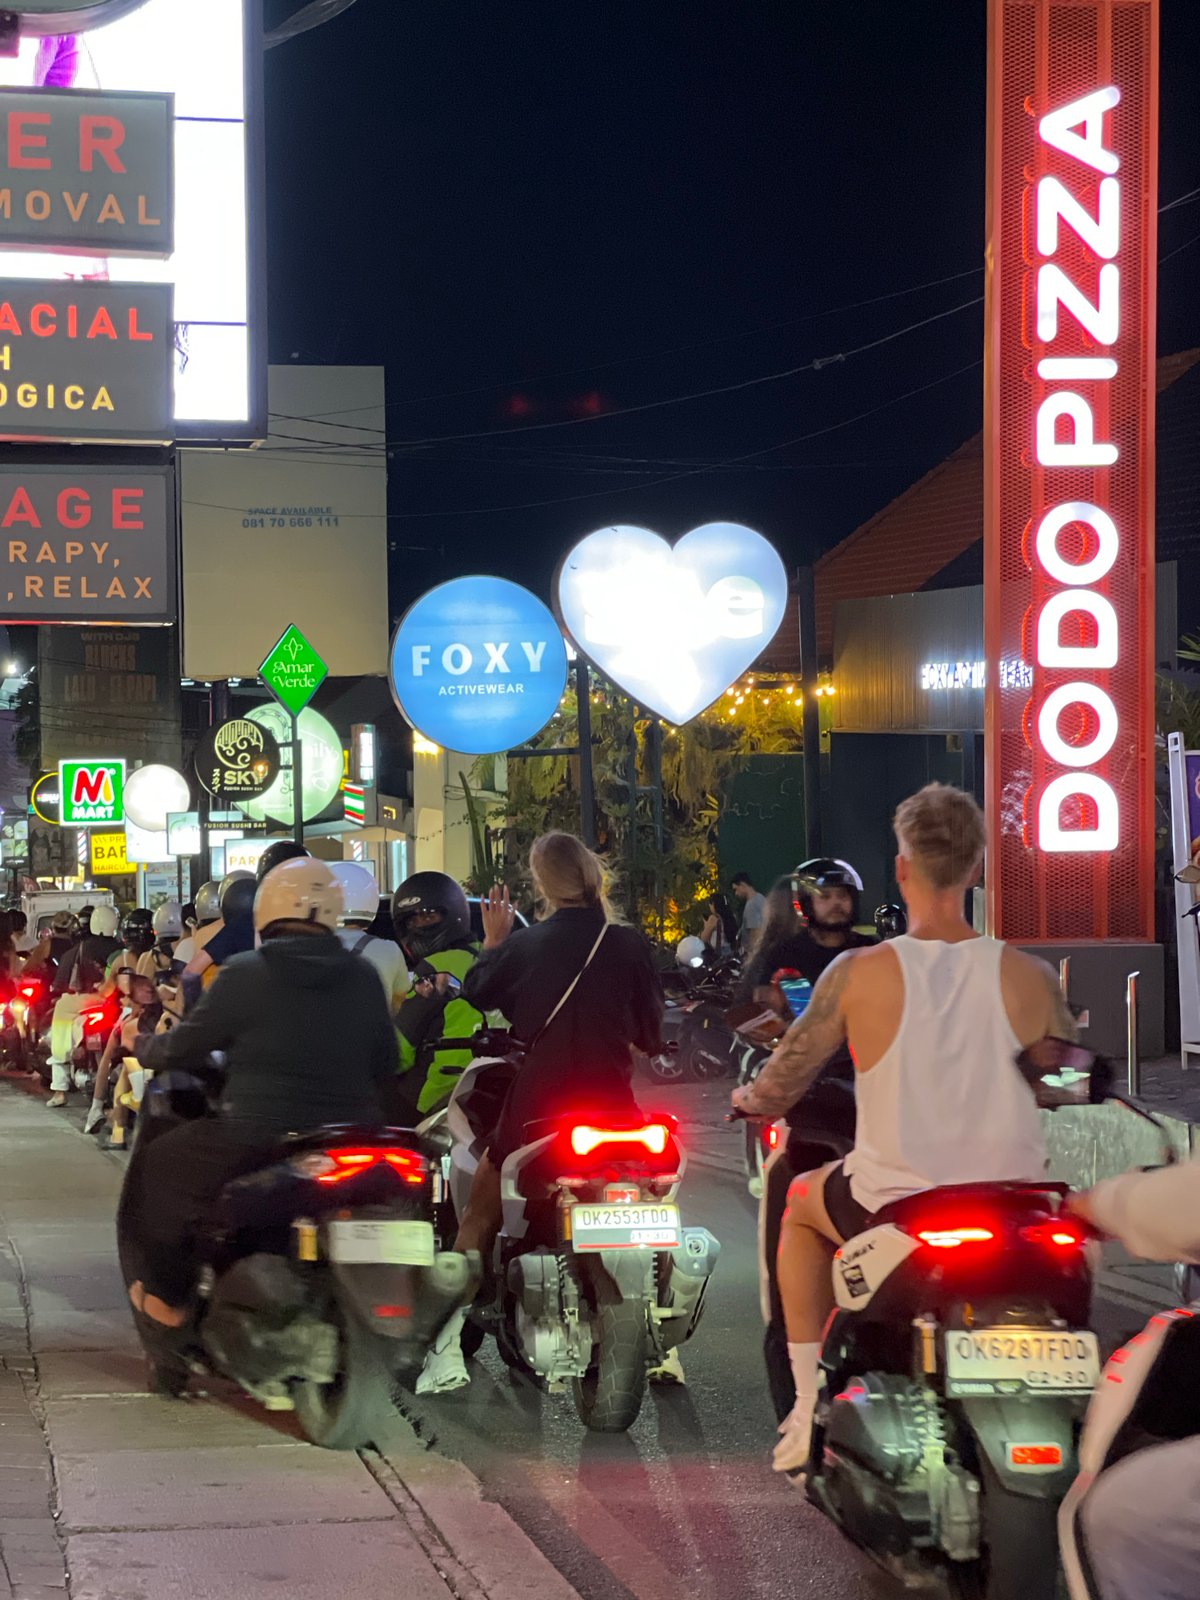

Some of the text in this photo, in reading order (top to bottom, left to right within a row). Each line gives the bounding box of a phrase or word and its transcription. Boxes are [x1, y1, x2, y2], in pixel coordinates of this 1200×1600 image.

[7, 111, 127, 174] ER
[1036, 85, 1121, 853] DODO PIZZA
[1, 486, 144, 529] AGE
[269, 518, 285, 528] 70
[317, 517, 340, 527] 111
[8, 541, 120, 568] RAPY,
[412, 641, 547, 677] FOXY
[272, 661, 315, 674] Amar
[272, 673, 316, 688] Verde
[438, 683, 525, 697] ACTIVEWEAR
[223, 770, 264, 785] SKY
[72, 806, 115, 820] MART
